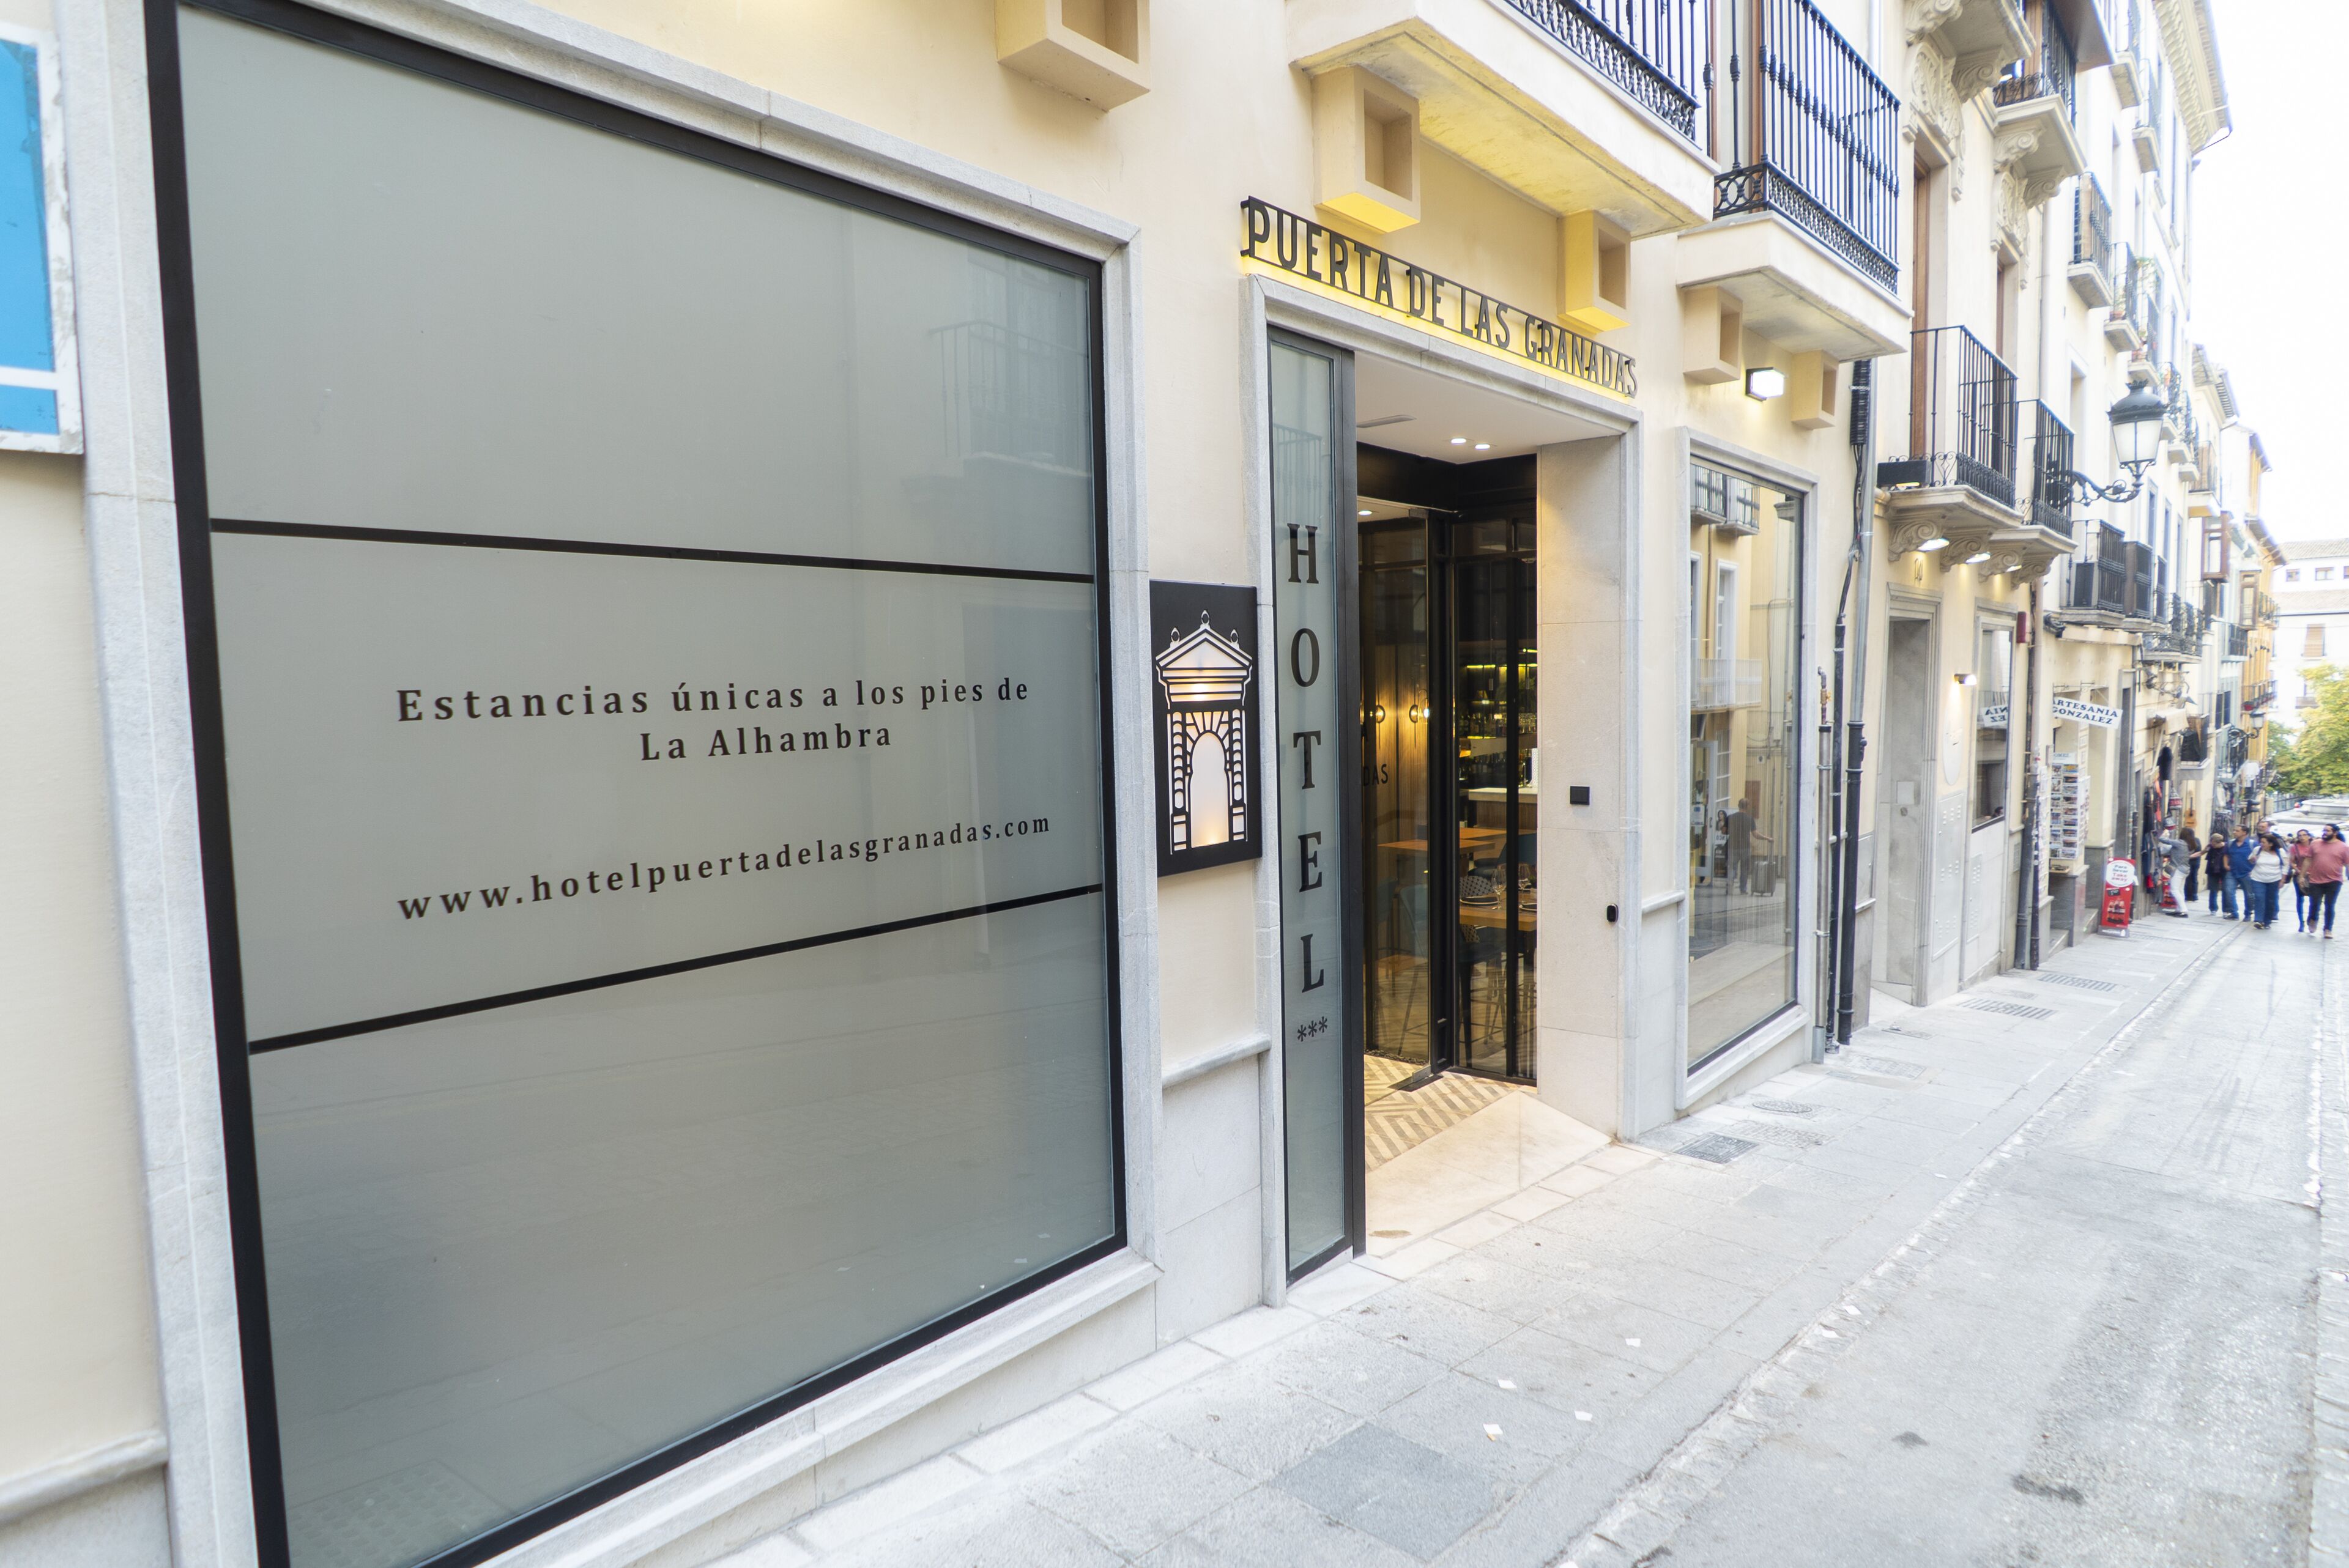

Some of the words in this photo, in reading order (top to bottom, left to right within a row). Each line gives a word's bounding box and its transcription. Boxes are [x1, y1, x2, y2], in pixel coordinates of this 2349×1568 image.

[1249, 202, 1394, 309] PUERTA
[1408, 265, 1445, 327] DE
[1461, 286, 1511, 350] LAS
[1524, 313, 1638, 399] GRANADAS
[396, 685, 648, 722] Estancias
[671, 682, 804, 711] únicas
[822, 686, 839, 707] a
[855, 679, 904, 706] los
[920, 678, 984, 711] pies
[997, 677, 1028, 701] de
[639, 733, 687, 761] La
[708, 722, 891, 757] Alhambra
[1286, 522, 1325, 993] HOTEL
[396, 813, 1051, 921] www.hotelpuertadelasgranadas.com
